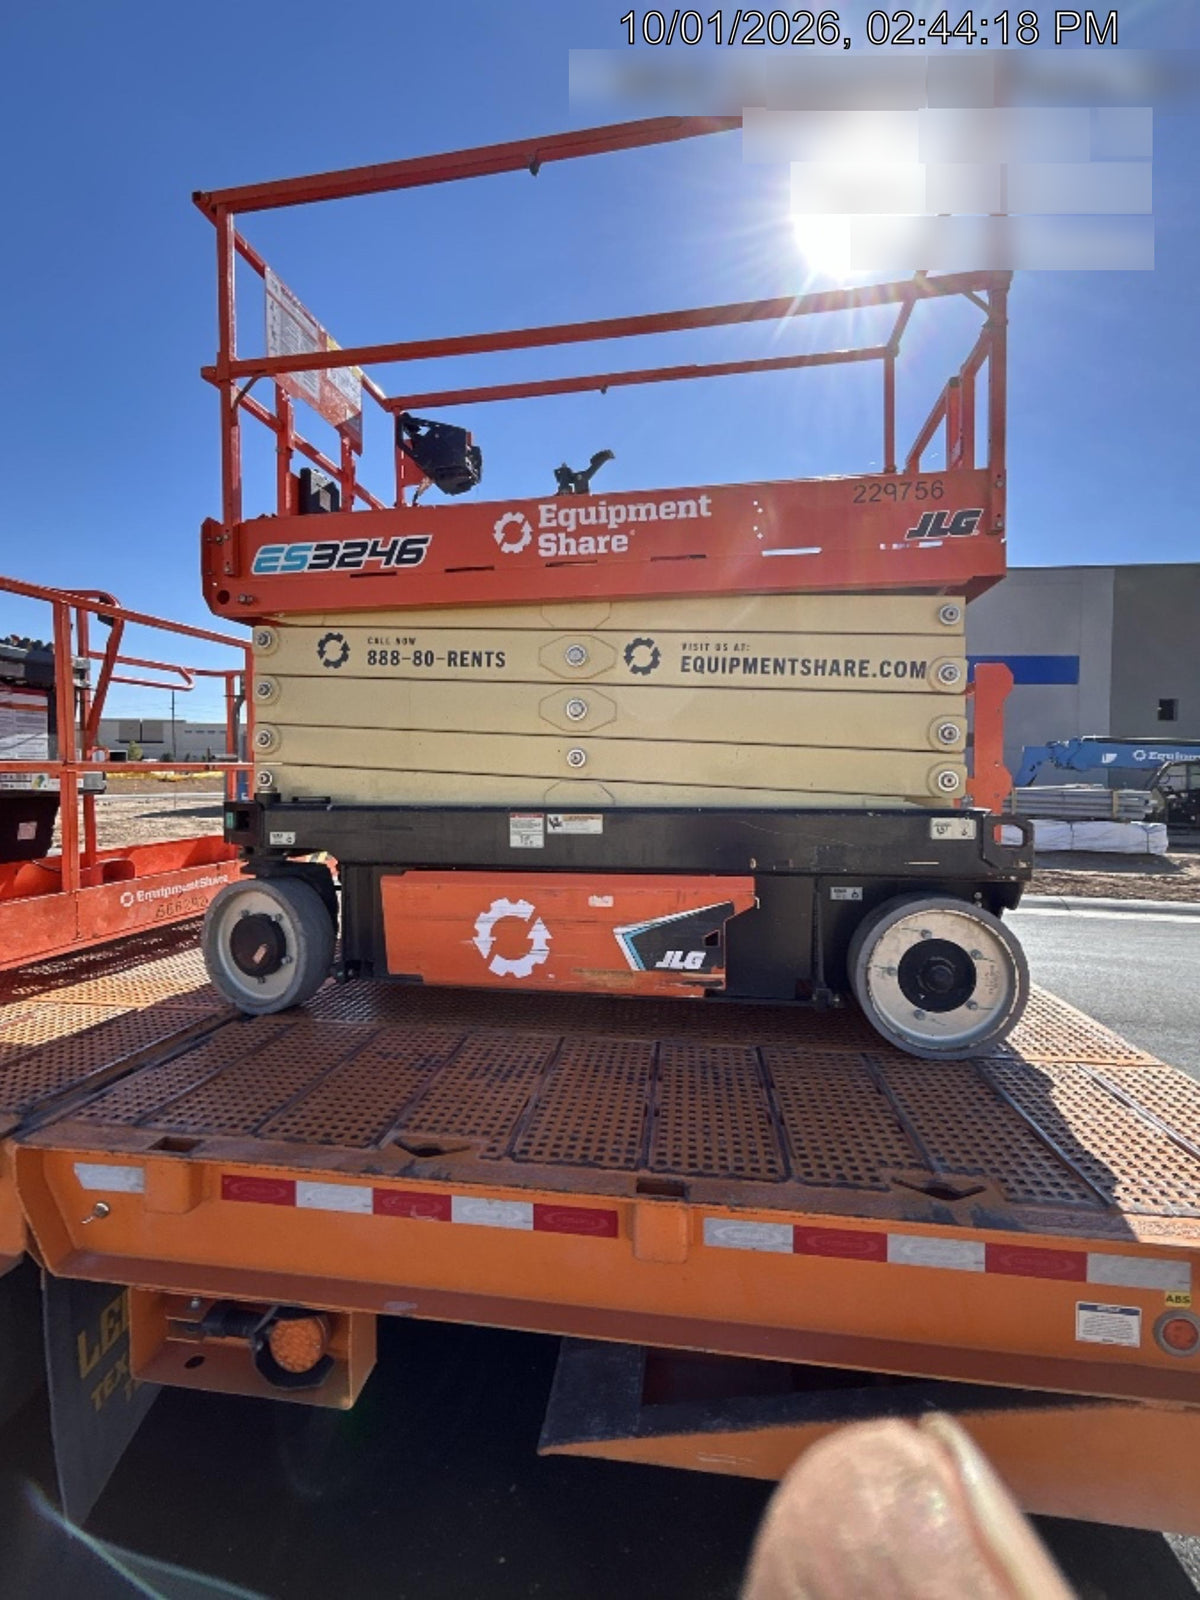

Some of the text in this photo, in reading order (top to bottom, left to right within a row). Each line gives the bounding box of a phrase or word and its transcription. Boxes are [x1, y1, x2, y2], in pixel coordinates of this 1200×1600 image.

[853, 480, 945, 504] 229756
[538, 496, 711, 529] Equipment
[905, 508, 984, 540] JLG
[253, 536, 432, 574] ES3246
[537, 531, 629, 558] Share
[367, 637, 416, 646] CALL NOW
[681, 643, 711, 652] VISIT
[367, 650, 506, 668] 888-80-RENTS
[680, 656, 928, 680] EQUIPMENTSHARE.COM
[655, 950, 707, 970] JLG
[1166, 1294, 1191, 1306] ABS
